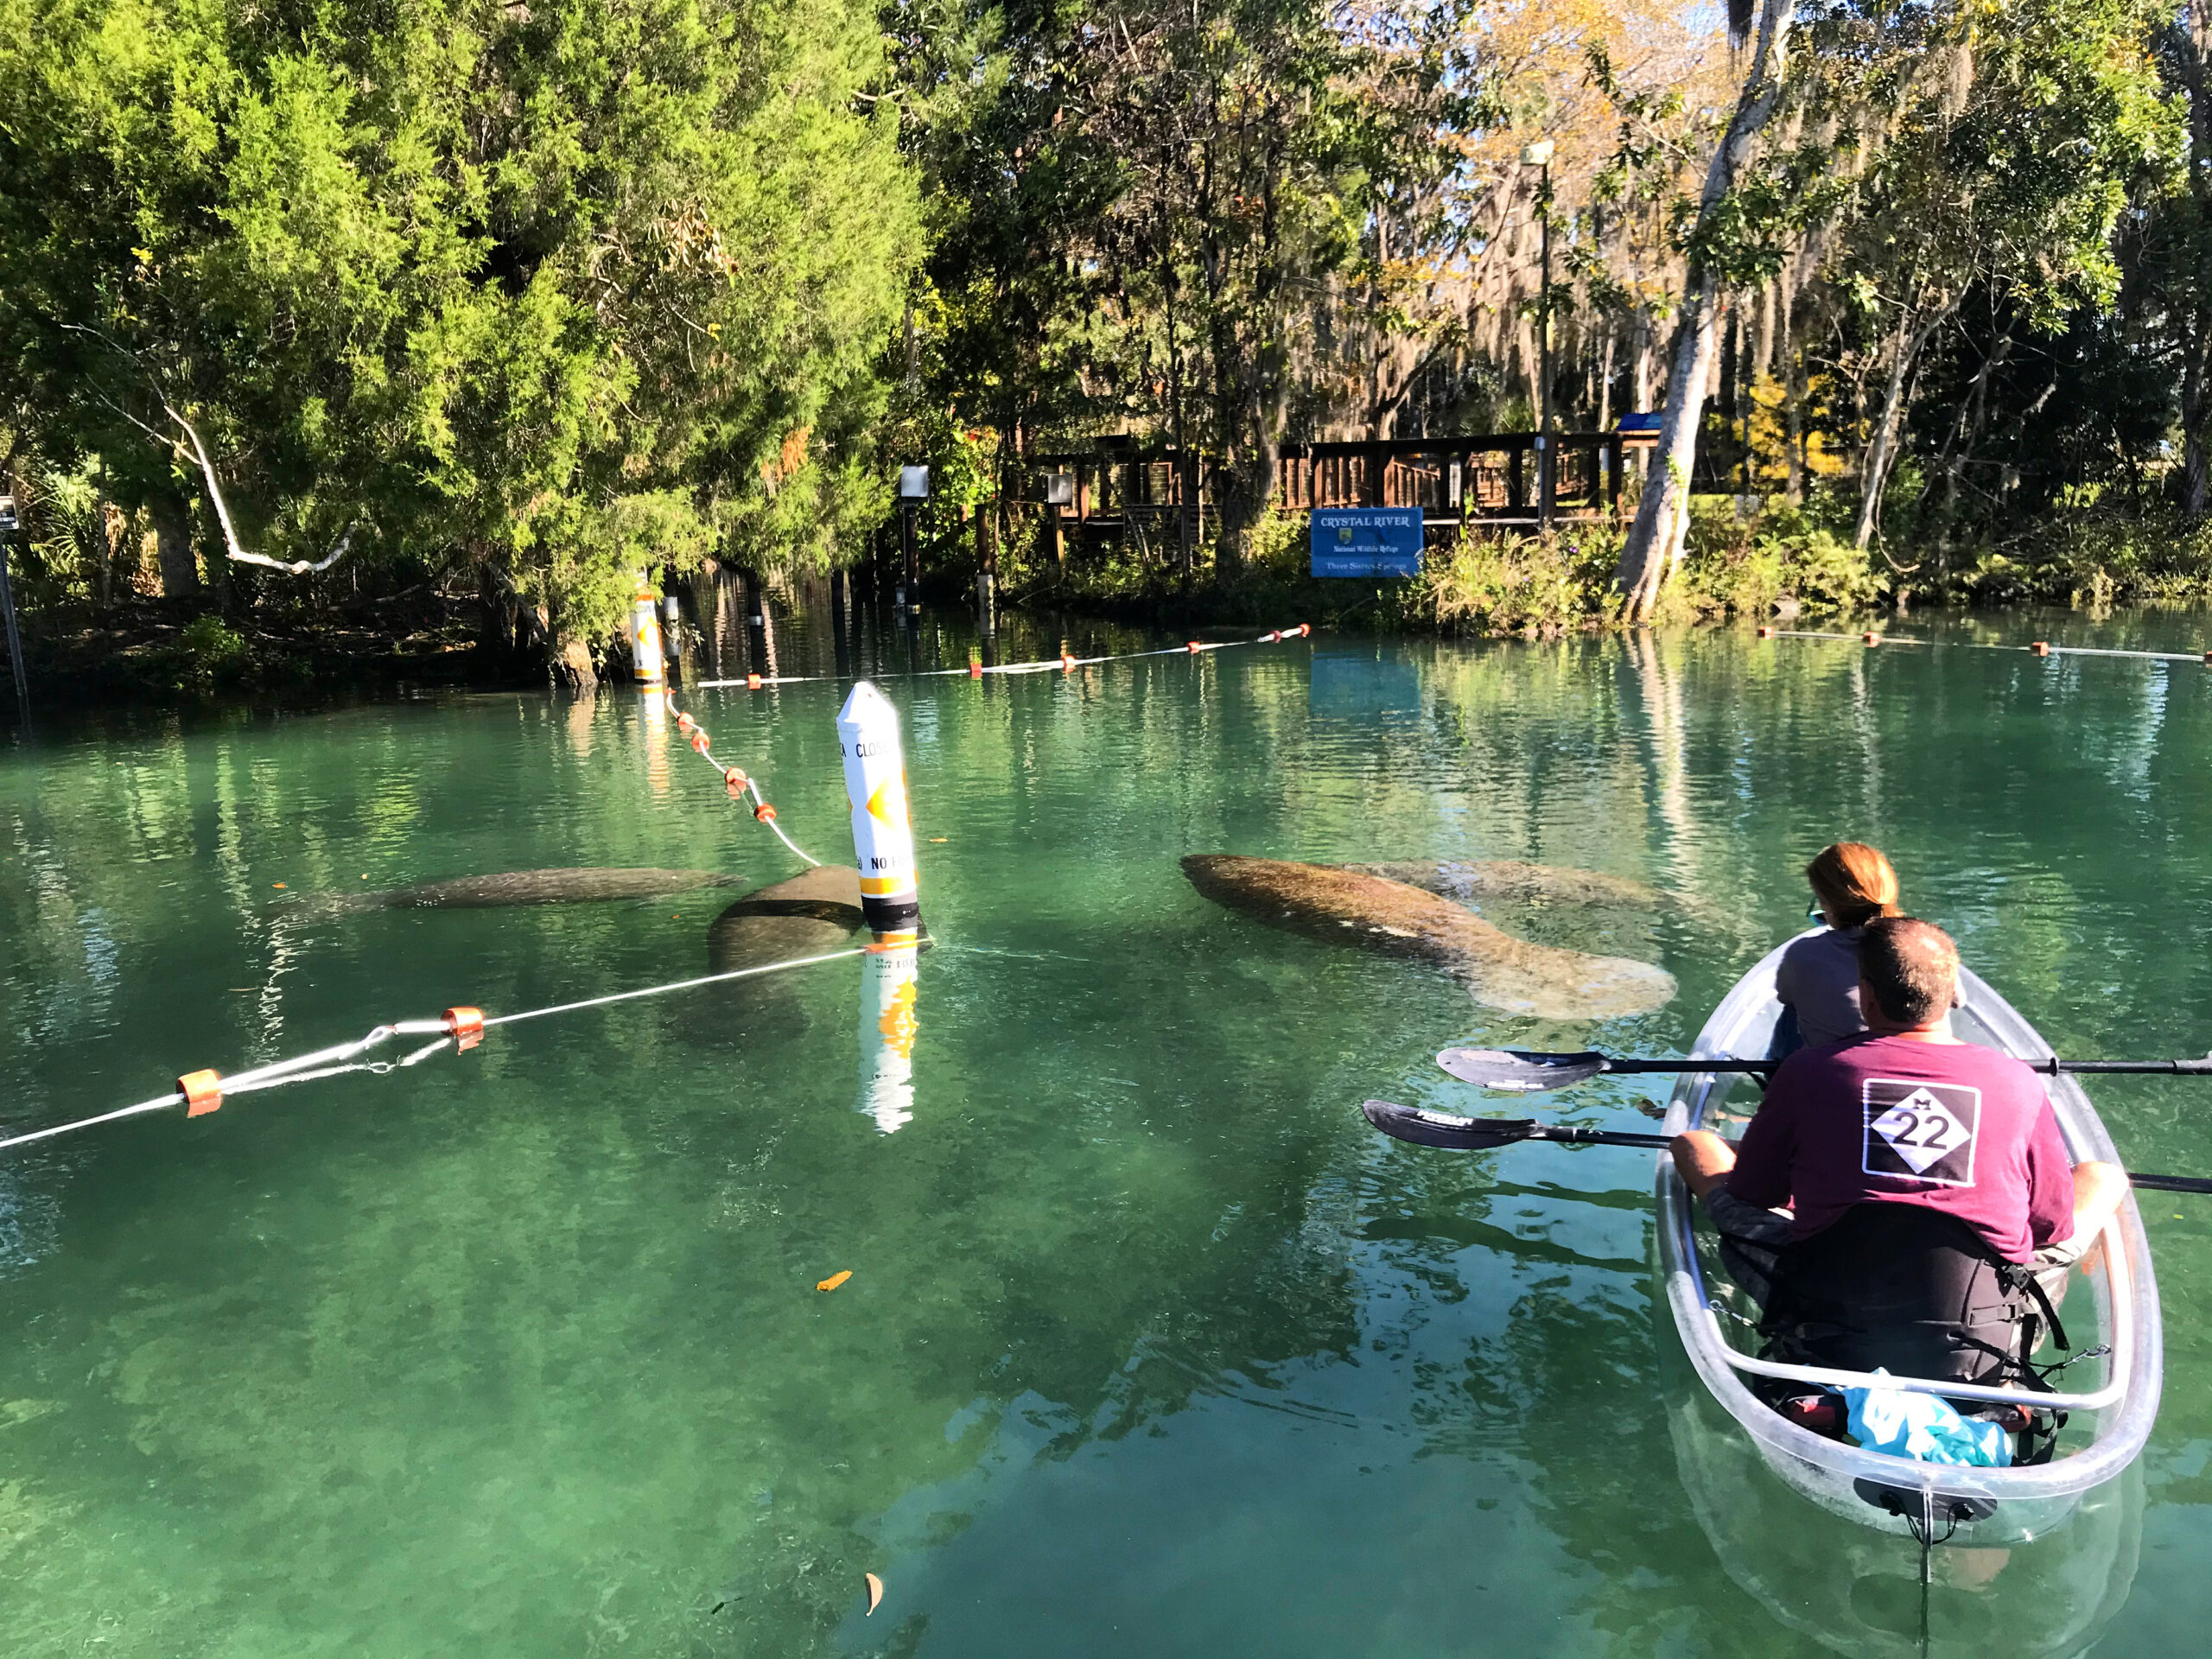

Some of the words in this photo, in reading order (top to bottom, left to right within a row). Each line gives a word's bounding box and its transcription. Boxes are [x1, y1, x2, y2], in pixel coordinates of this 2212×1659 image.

[1320, 518, 1371, 528] CRYSTAL
[1374, 517, 1410, 527] RIVER
[1379, 545, 1399, 554] Refuge
[1326, 562, 1348, 570] Three
[870, 856, 887, 870] NO
[1912, 1098, 1931, 1111] M
[1892, 1112, 1949, 1150] 22
